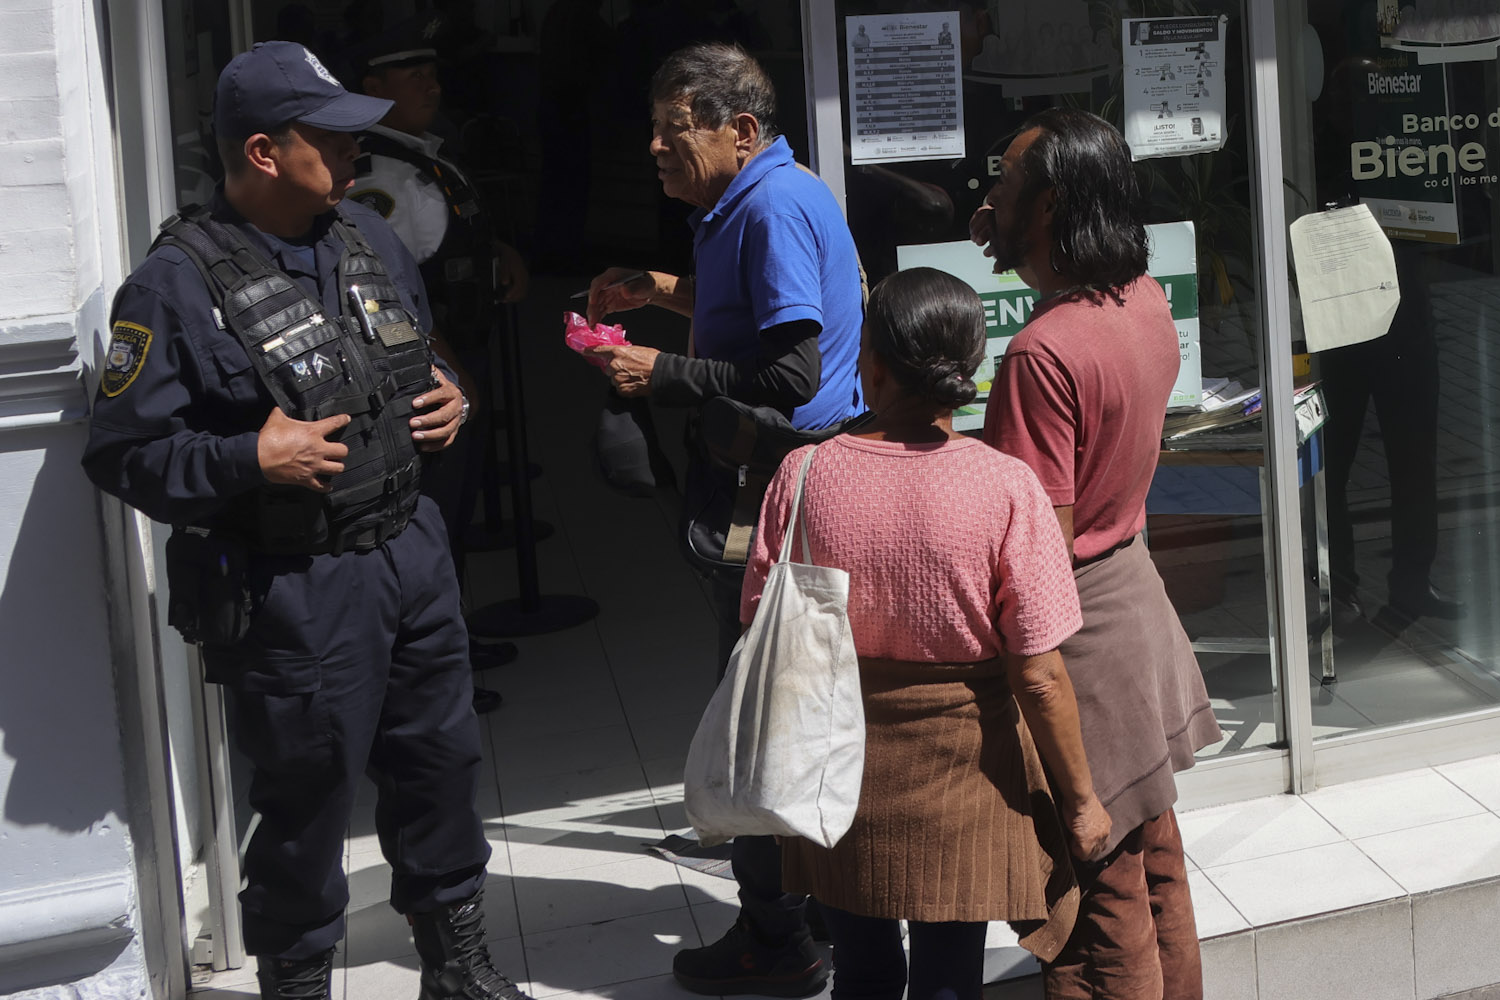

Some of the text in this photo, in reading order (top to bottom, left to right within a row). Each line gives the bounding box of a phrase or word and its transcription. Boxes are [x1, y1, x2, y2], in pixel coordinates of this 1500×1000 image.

[1367, 72, 1422, 95] Bienestar
[1402, 112, 1480, 134] Banco
[1459, 174, 1476, 186] los
